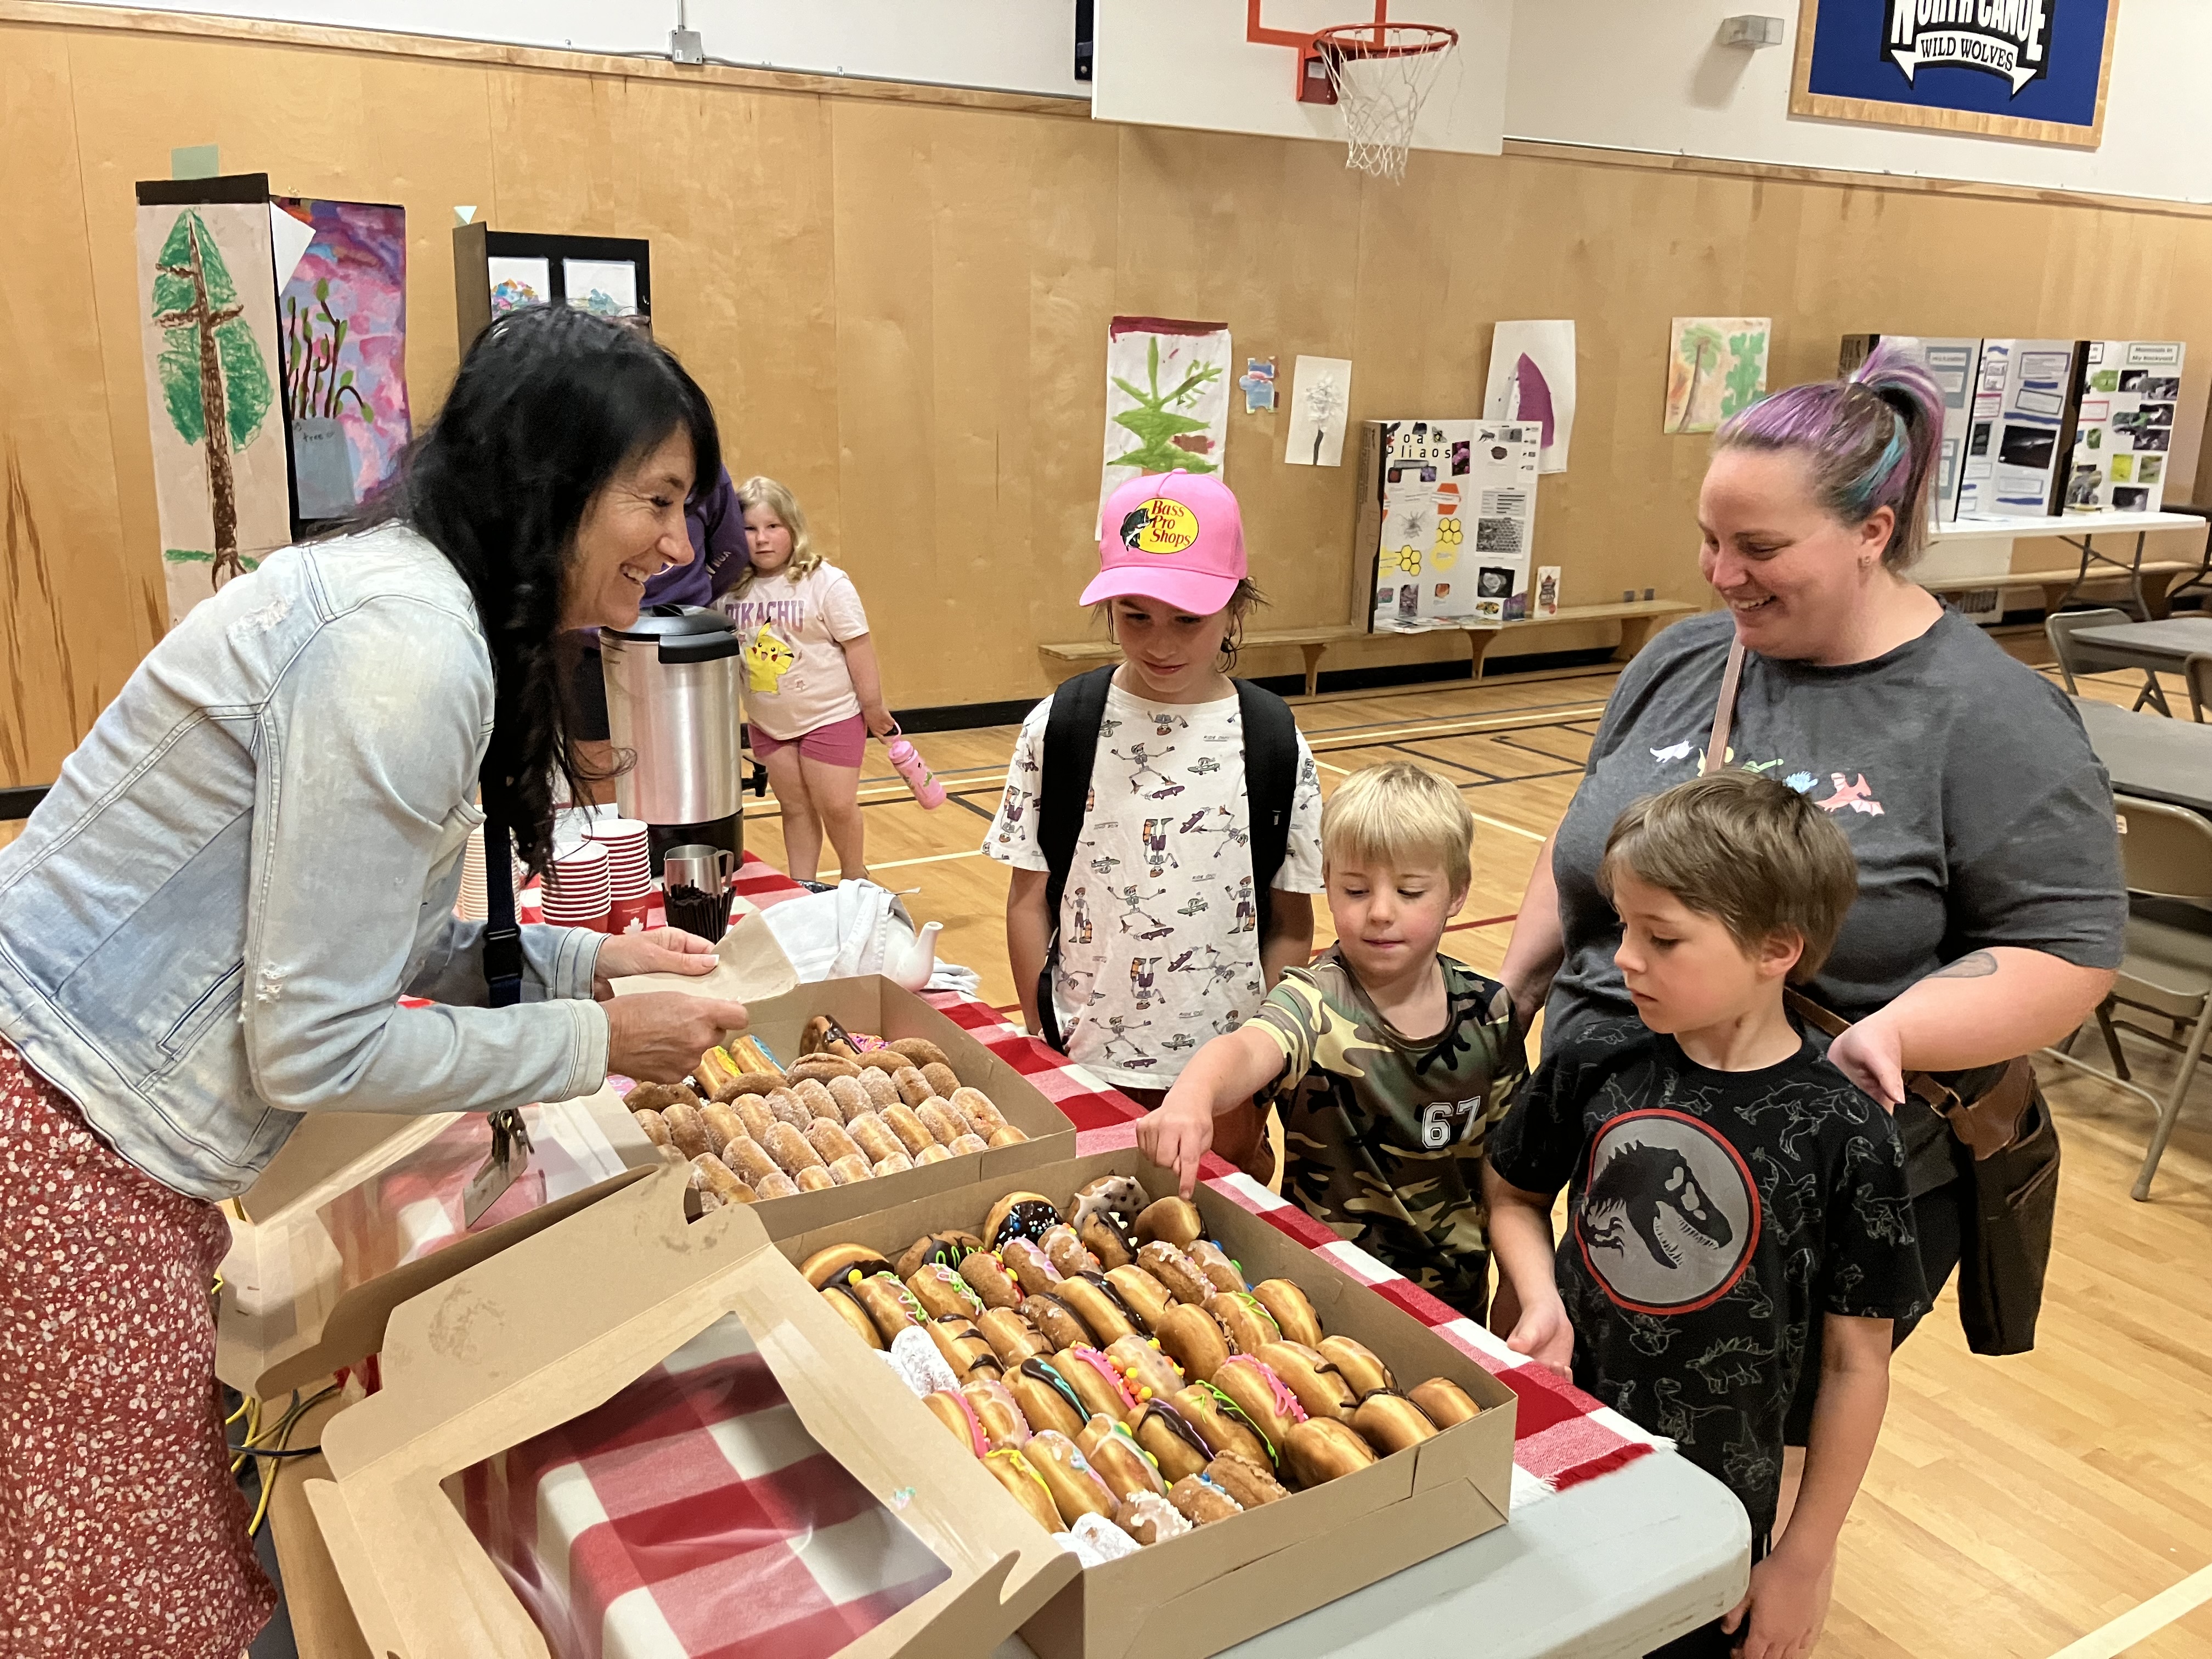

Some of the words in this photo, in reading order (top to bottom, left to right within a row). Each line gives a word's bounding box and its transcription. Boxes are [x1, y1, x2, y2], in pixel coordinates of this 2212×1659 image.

[1921, 37, 1956, 58] WILD
[1961, 38, 2013, 71] WOLVES
[1151, 500, 1185, 517] Bass
[1151, 515, 1176, 529] Pro
[1149, 528, 1191, 548] Shops
[1422, 1096, 1481, 1149] 67
